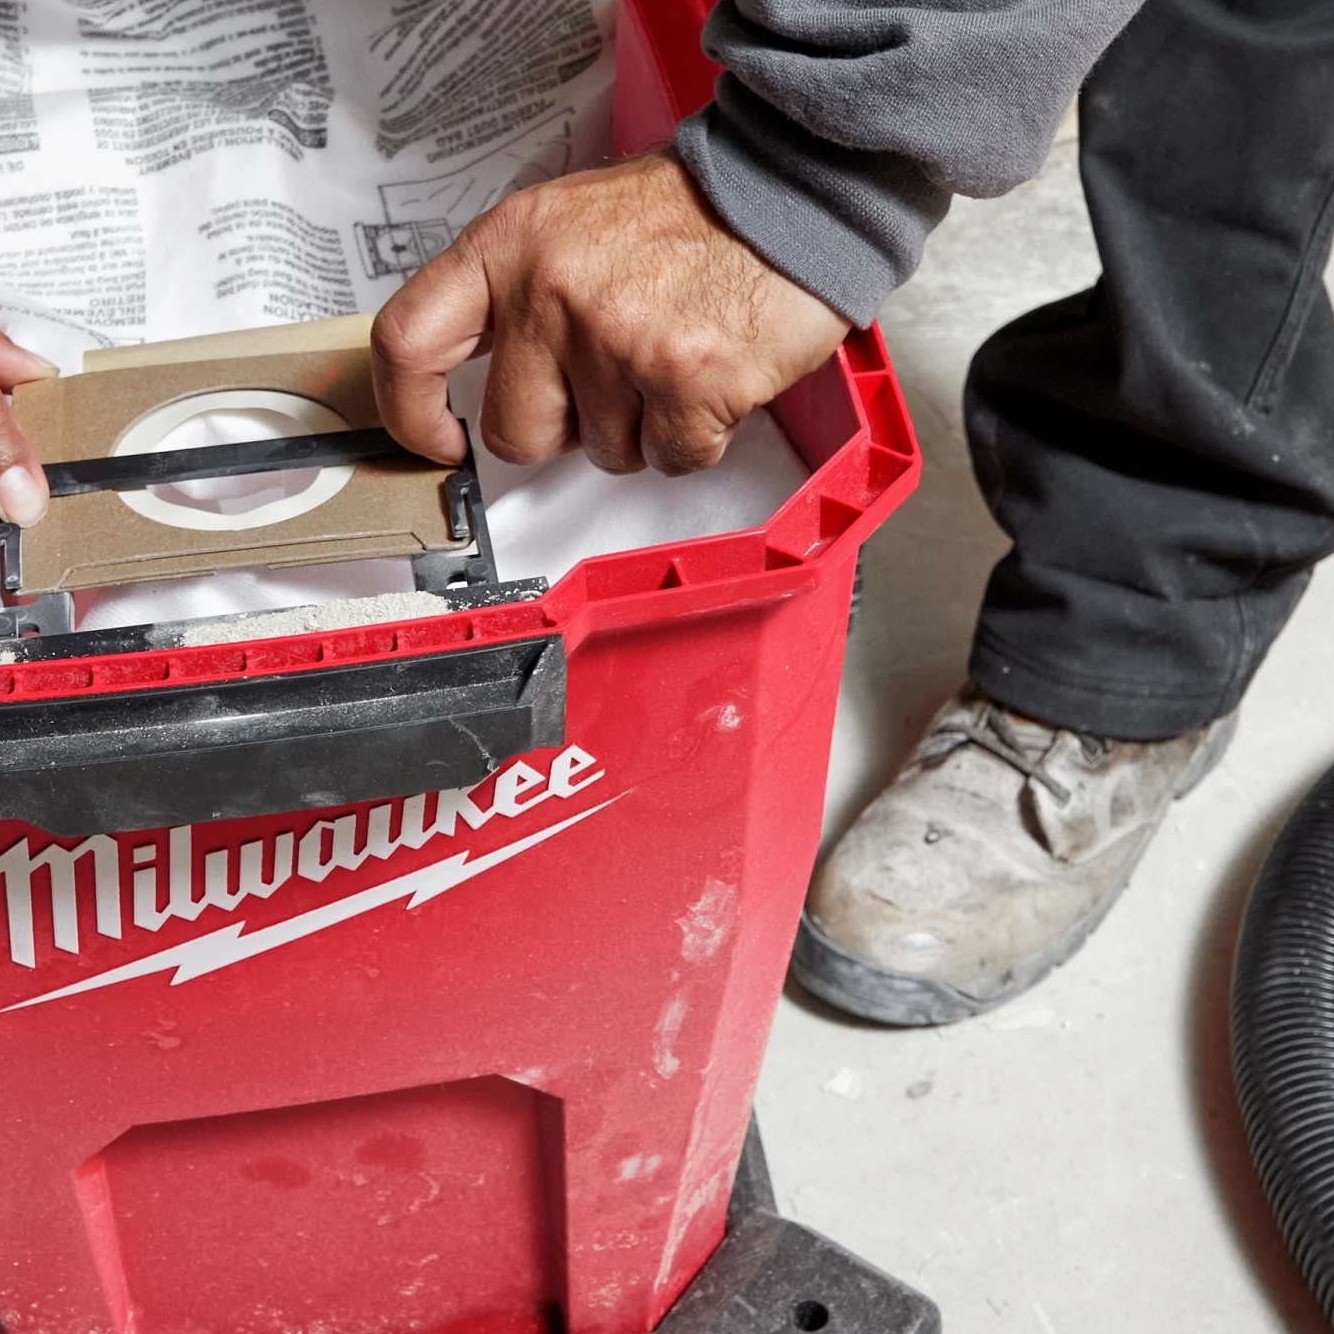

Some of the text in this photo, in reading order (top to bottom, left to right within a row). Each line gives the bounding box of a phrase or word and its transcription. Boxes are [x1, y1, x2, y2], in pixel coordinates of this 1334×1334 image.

[467, 118, 499, 137] DUST
[436, 131, 463, 148] BAG
[7, 160, 24, 173] DE
[89, 293, 146, 308] RETIRO
[84, 315, 146, 327] REMOVE
